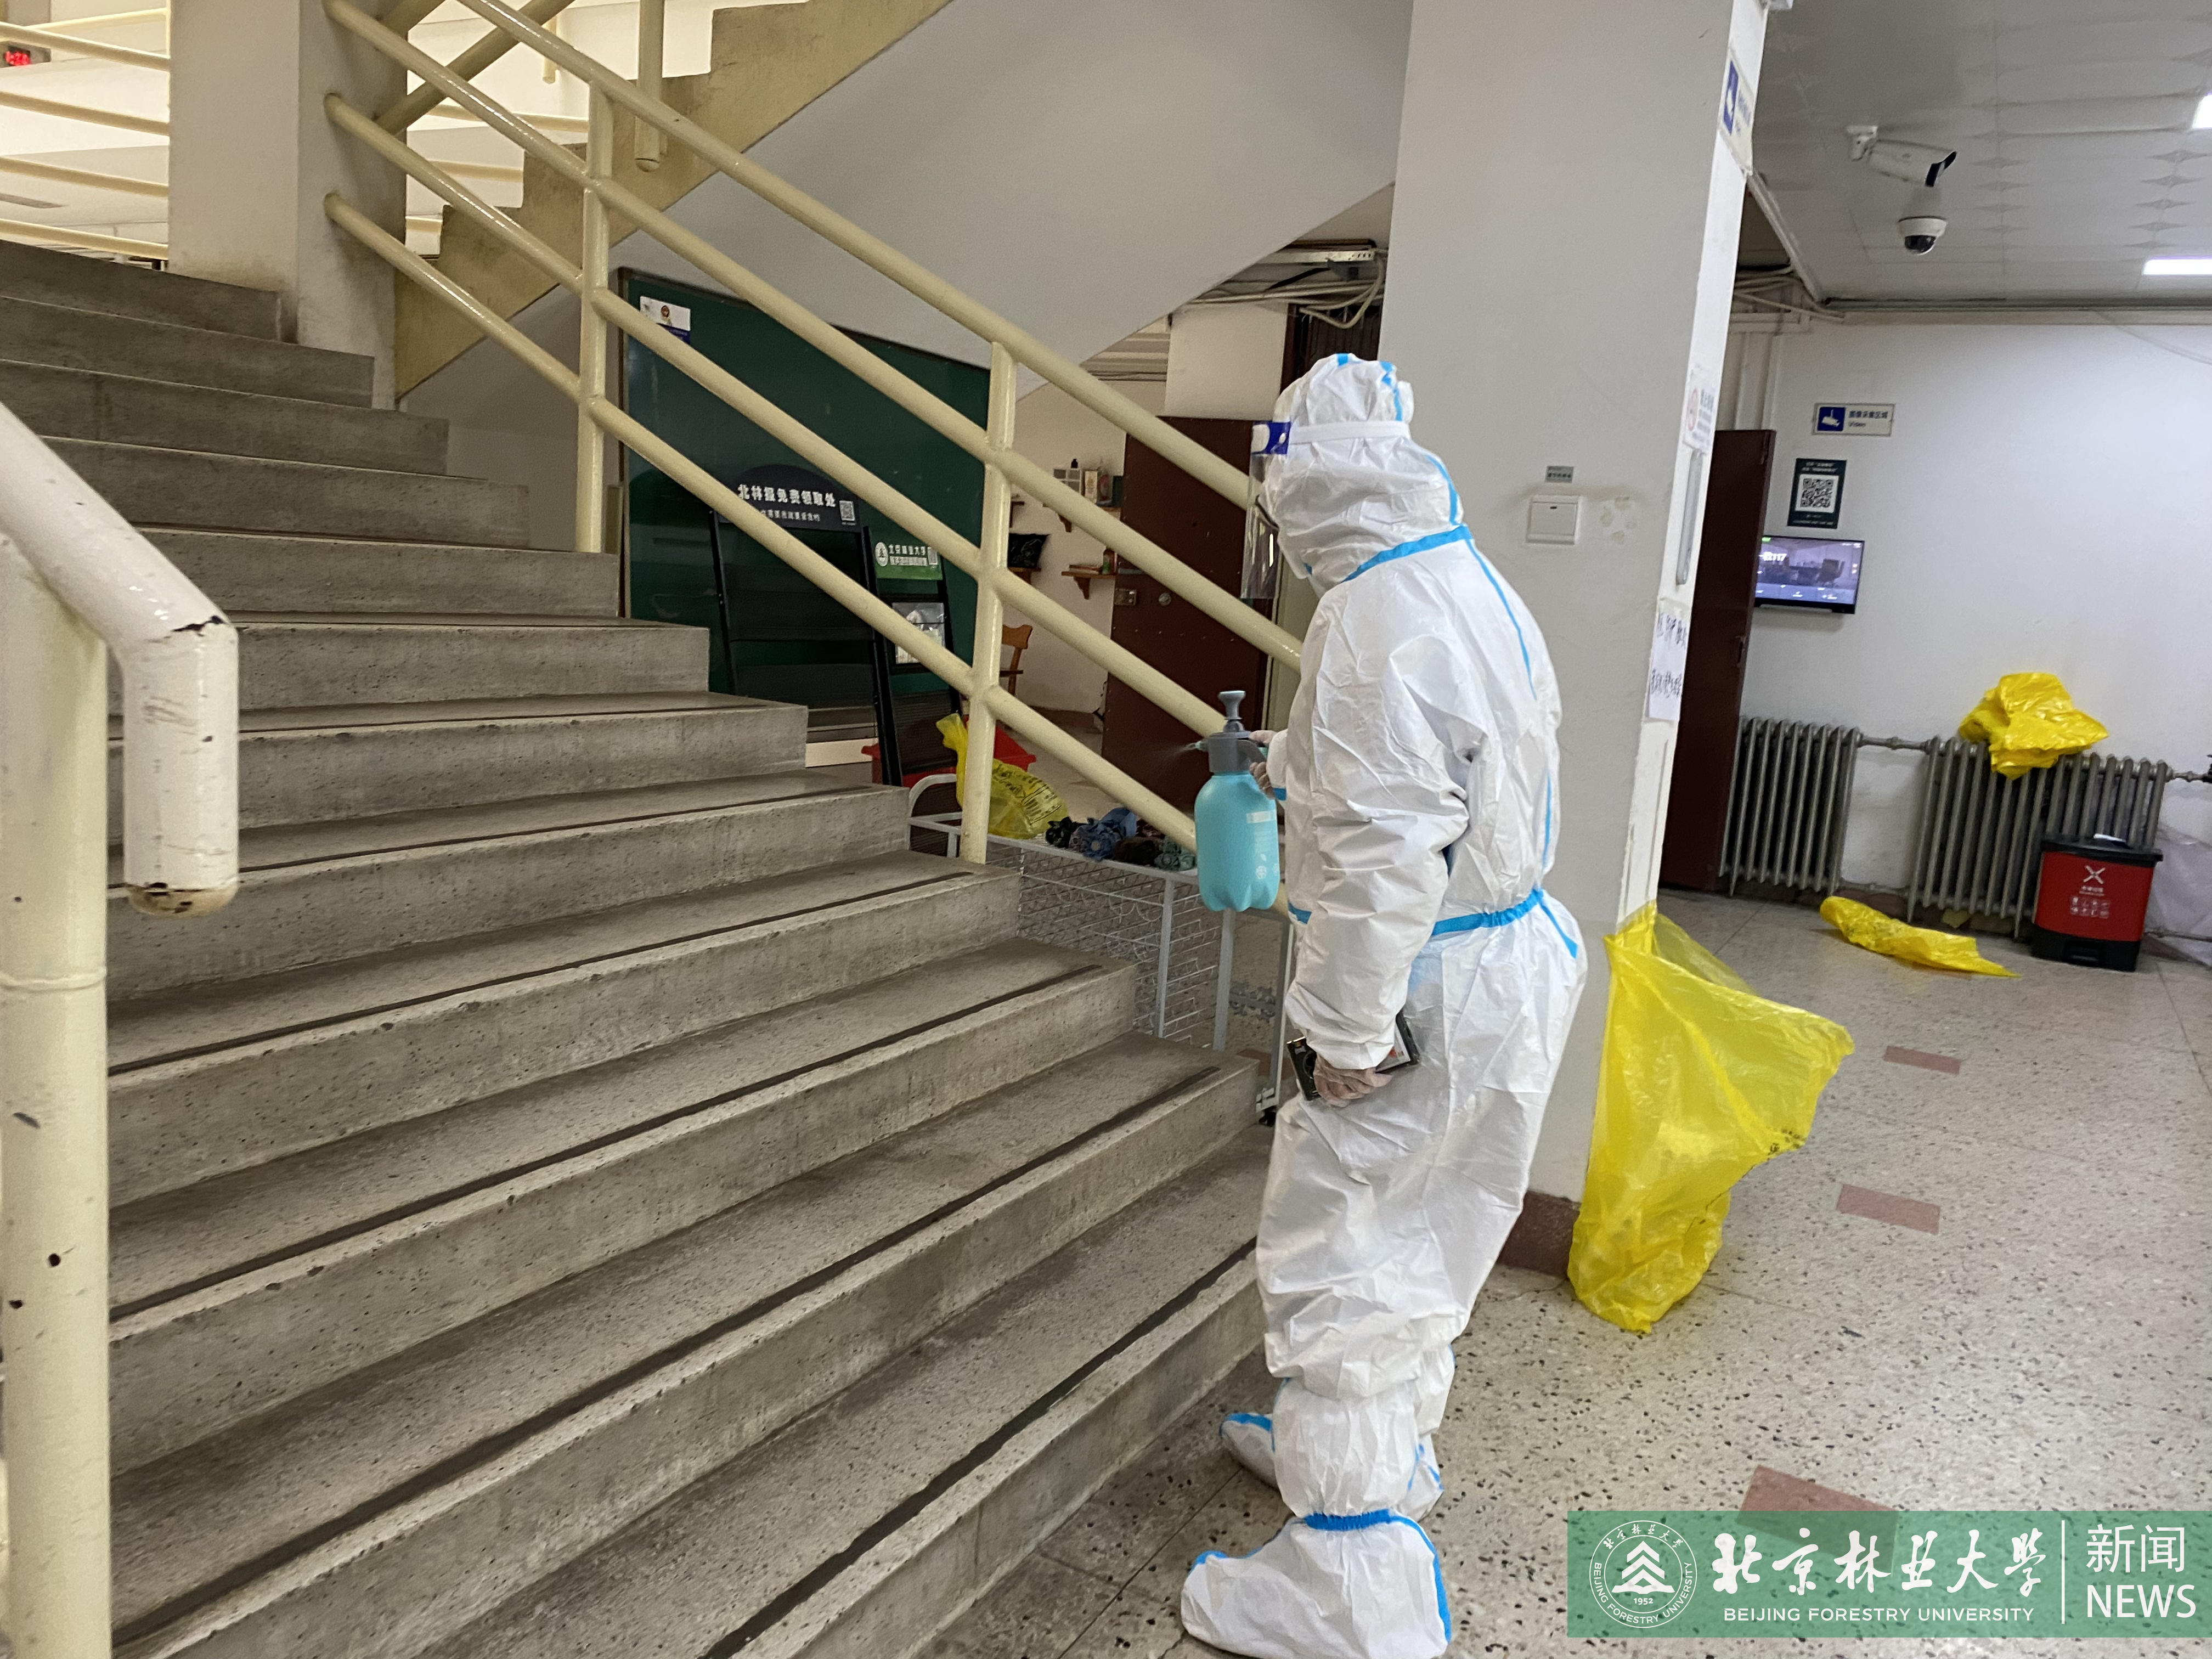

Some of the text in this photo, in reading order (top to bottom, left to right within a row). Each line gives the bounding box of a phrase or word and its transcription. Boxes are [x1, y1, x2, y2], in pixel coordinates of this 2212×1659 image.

[738, 484, 836, 507] 北林报免费领取处
